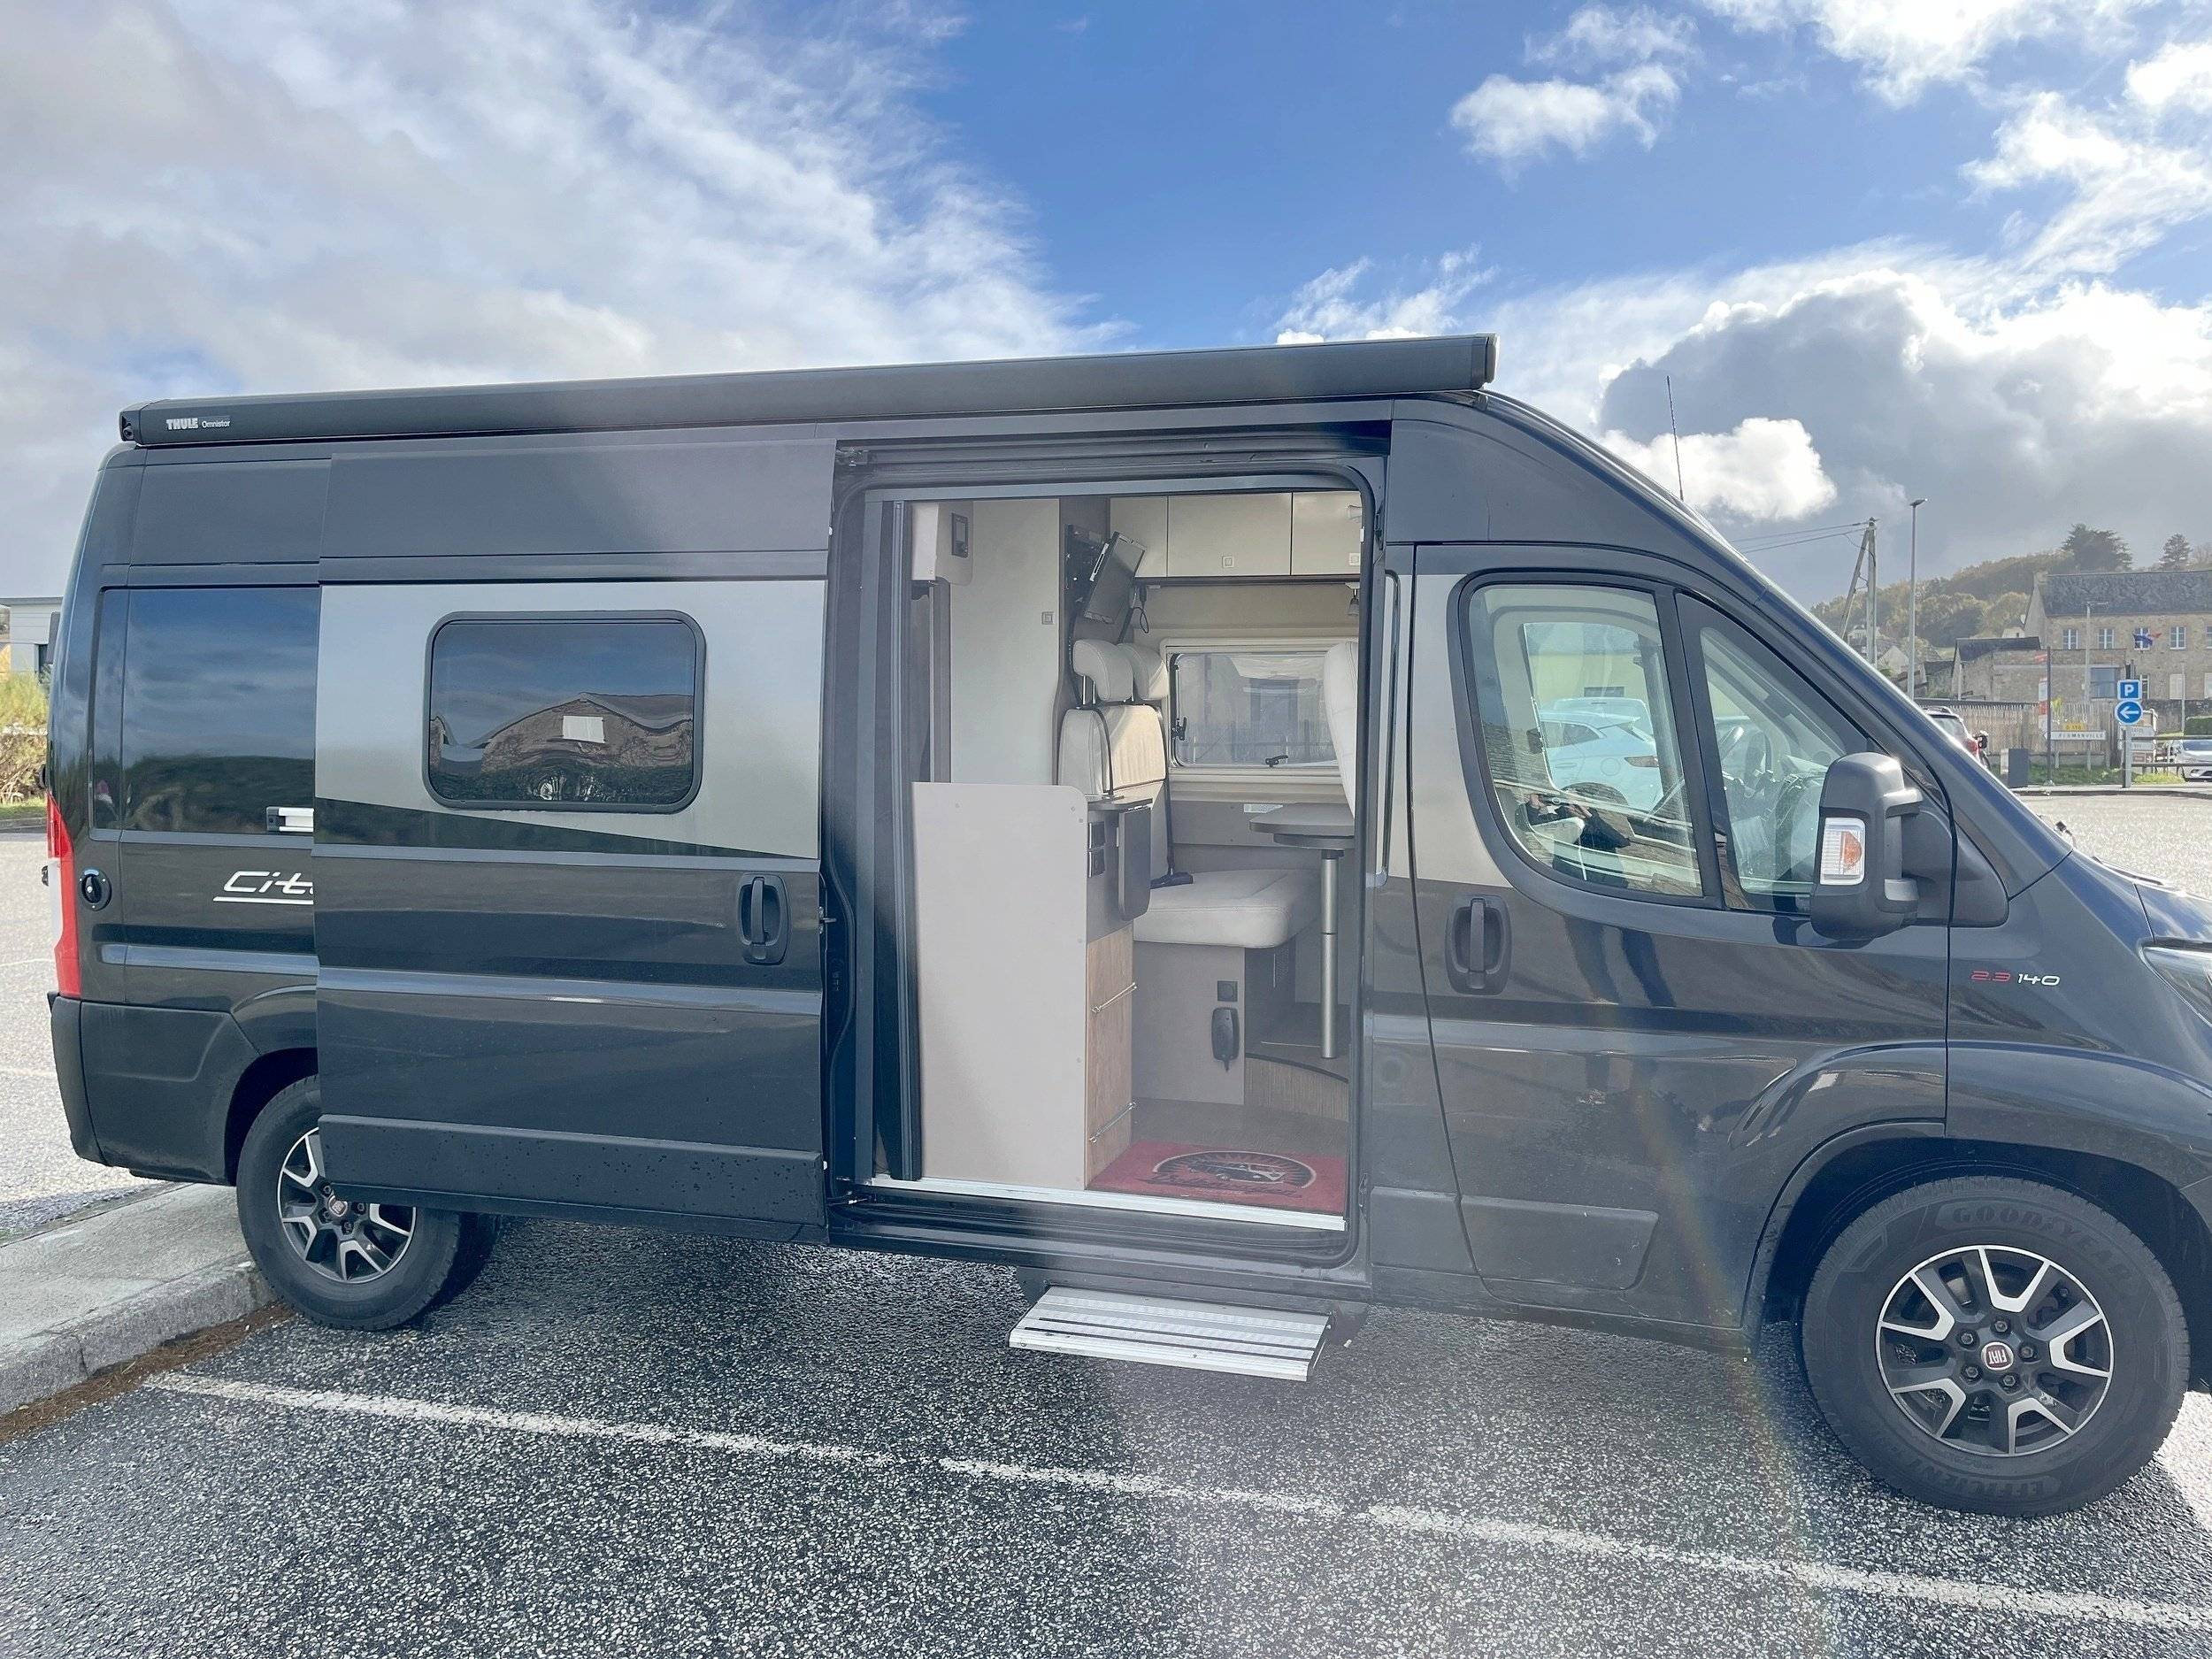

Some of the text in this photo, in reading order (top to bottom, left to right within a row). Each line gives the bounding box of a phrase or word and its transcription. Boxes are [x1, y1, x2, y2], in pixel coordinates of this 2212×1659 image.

[166, 417, 199, 430] THULE
[2124, 684, 2134, 696] P
[223, 871, 314, 895] Cit
[1970, 971, 2061, 986] 2.3 140
[1988, 1348, 2008, 1364] FIAT
